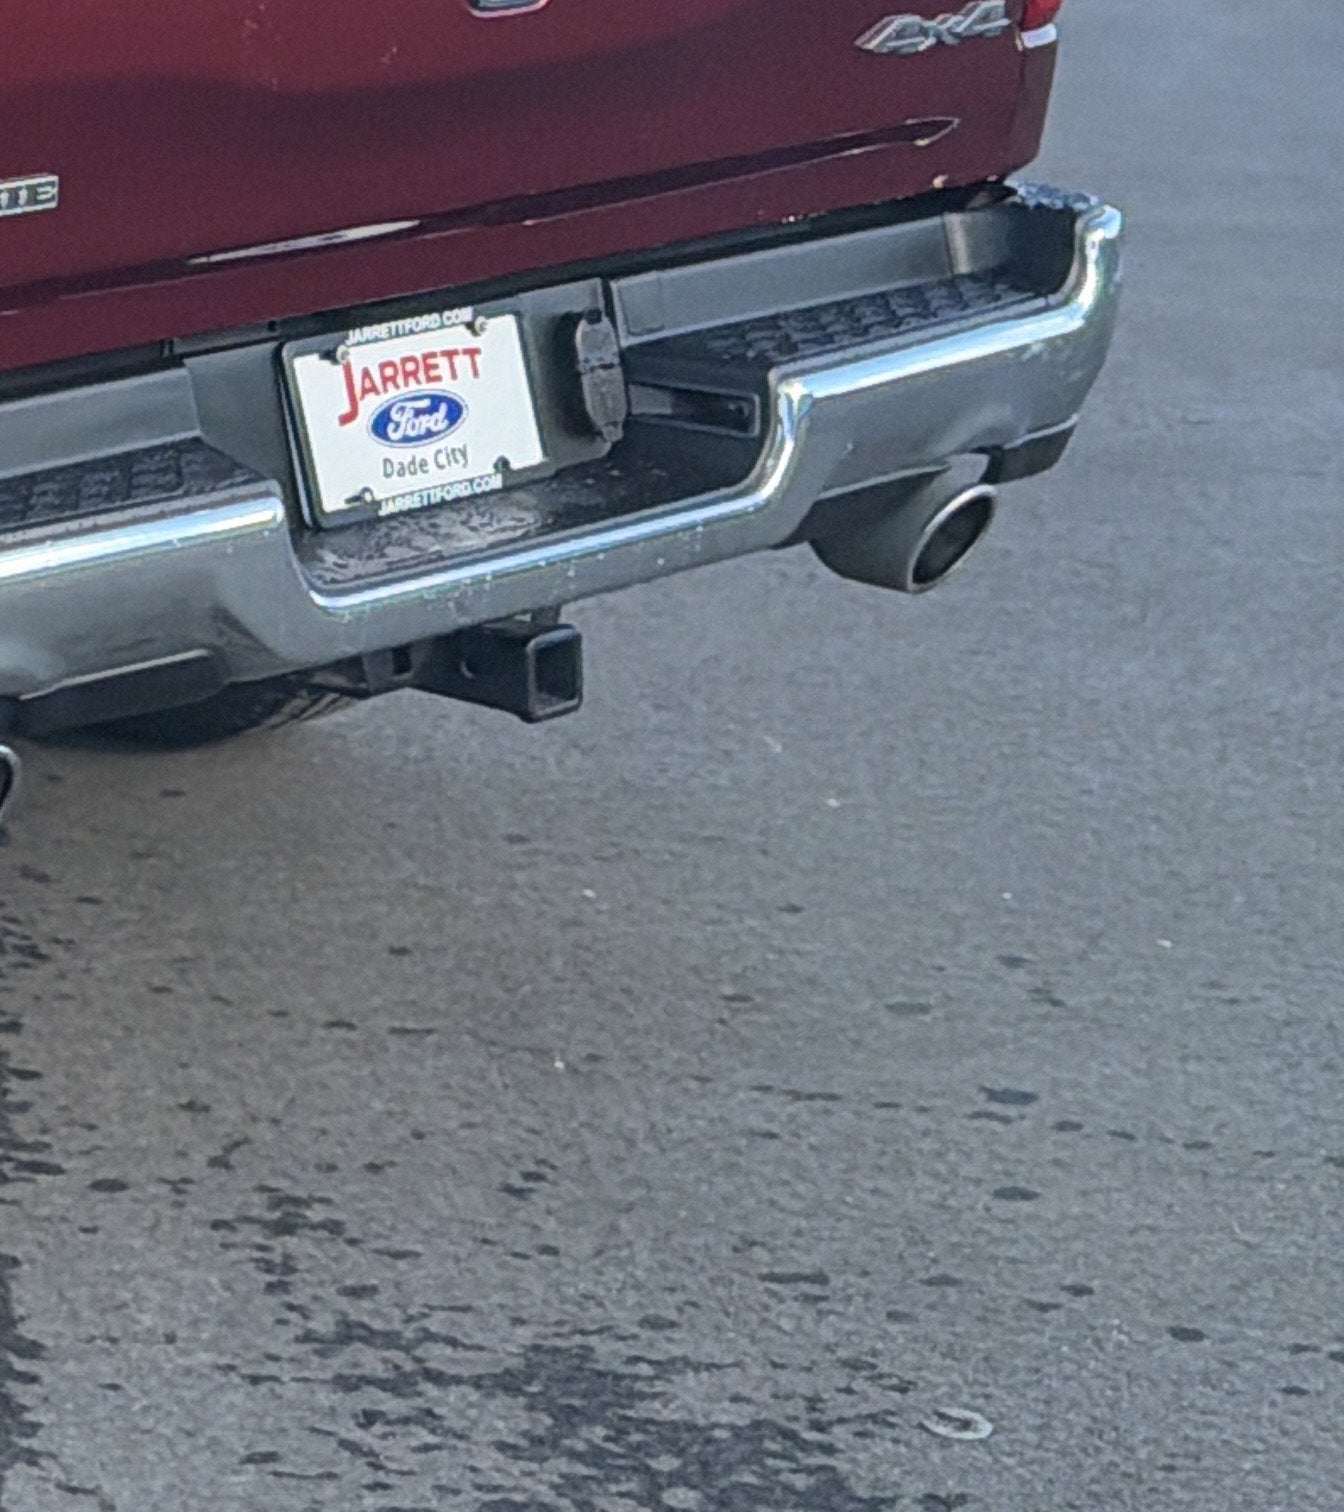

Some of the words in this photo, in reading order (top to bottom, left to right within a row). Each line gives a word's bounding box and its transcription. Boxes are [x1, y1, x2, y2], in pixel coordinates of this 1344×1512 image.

[338, 347, 482, 426] JARRETT
[387, 398, 449, 441] Ford
[382, 455, 429, 479] Dade
[433, 444, 468, 470] City
